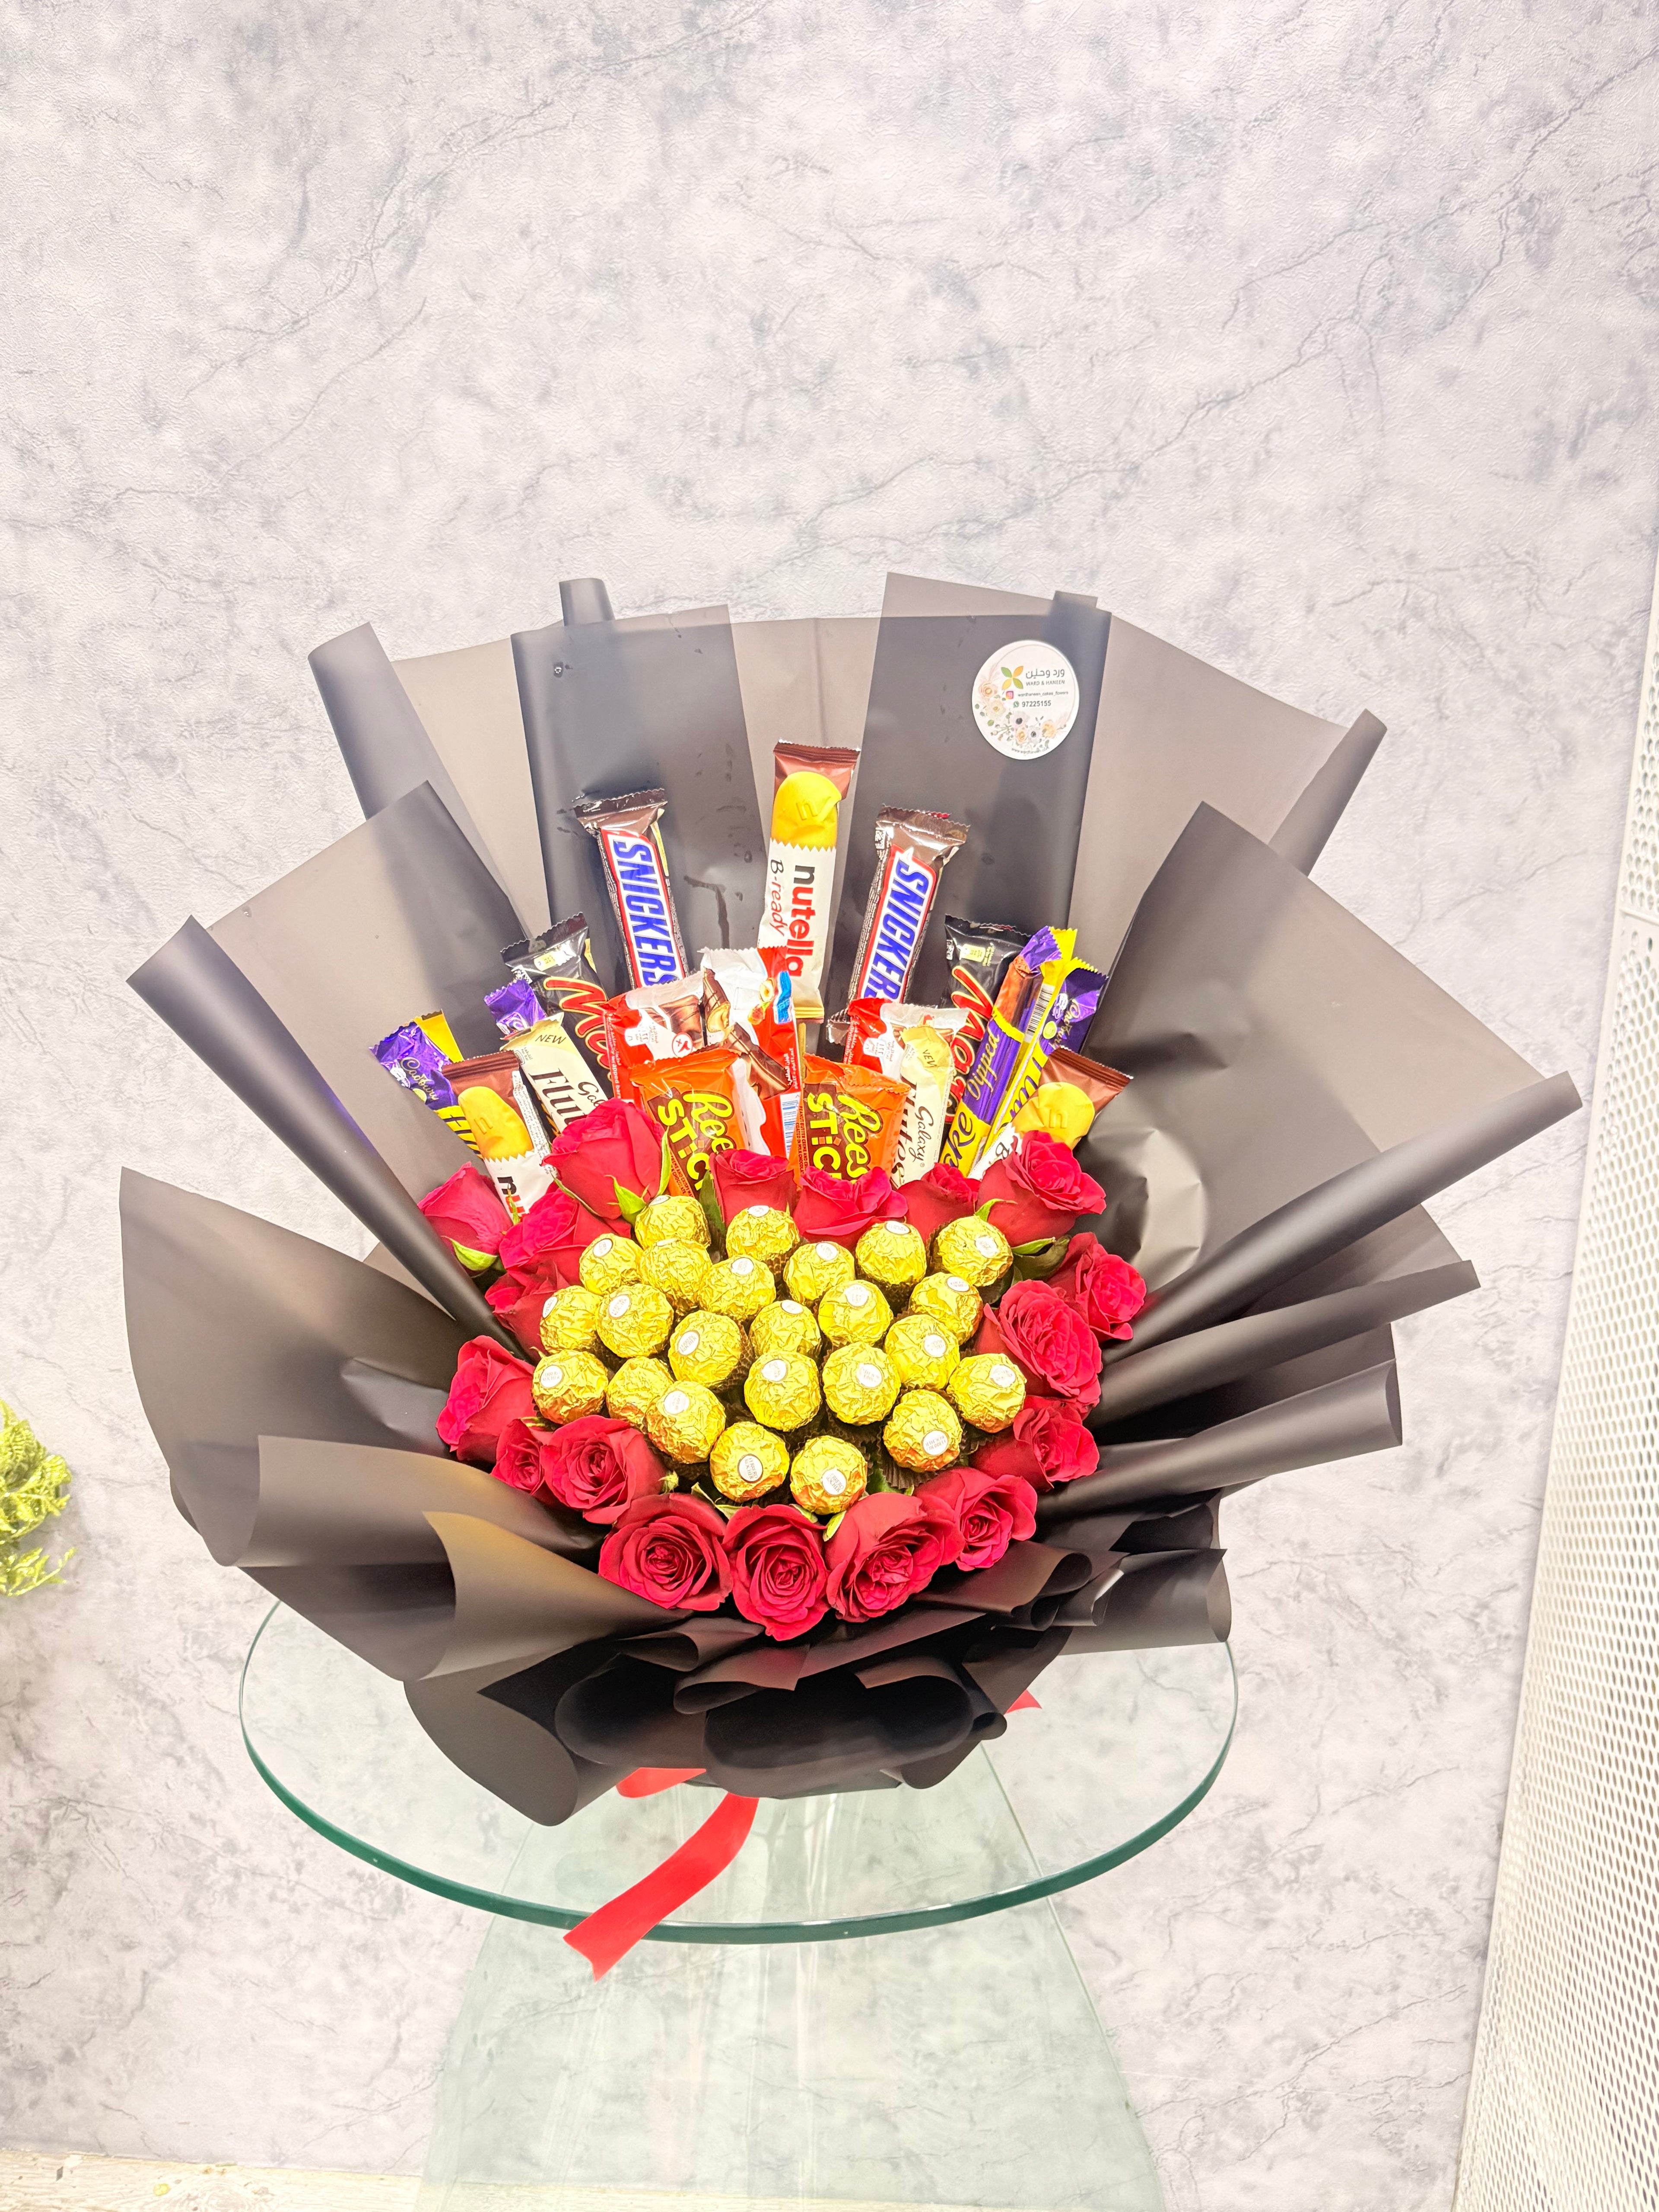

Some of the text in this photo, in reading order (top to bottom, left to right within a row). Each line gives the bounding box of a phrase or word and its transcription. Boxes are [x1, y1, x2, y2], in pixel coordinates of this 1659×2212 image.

[769, 859, 788, 937] B-ready
[787, 865, 816, 977] nutella
[864, 858, 929, 1000] SNICKER
[535, 1035, 567, 1045] NEW
[611, 1055, 620, 1084] wrapped
[966, 1022, 999, 1100] Dipped
[399, 1056, 439, 1102] Cadbury
[657, 1098, 713, 1191] STIC
[682, 1093, 734, 1155] Ree
[807, 1092, 842, 1180] STIC
[837, 1094, 881, 1185] Rees
[908, 1106, 934, 1163] Galaxy
[943, 1111, 976, 1168] ake
[744, 1459, 753, 1480] ROCHER
[748, 1457, 758, 1479] FERRERO
